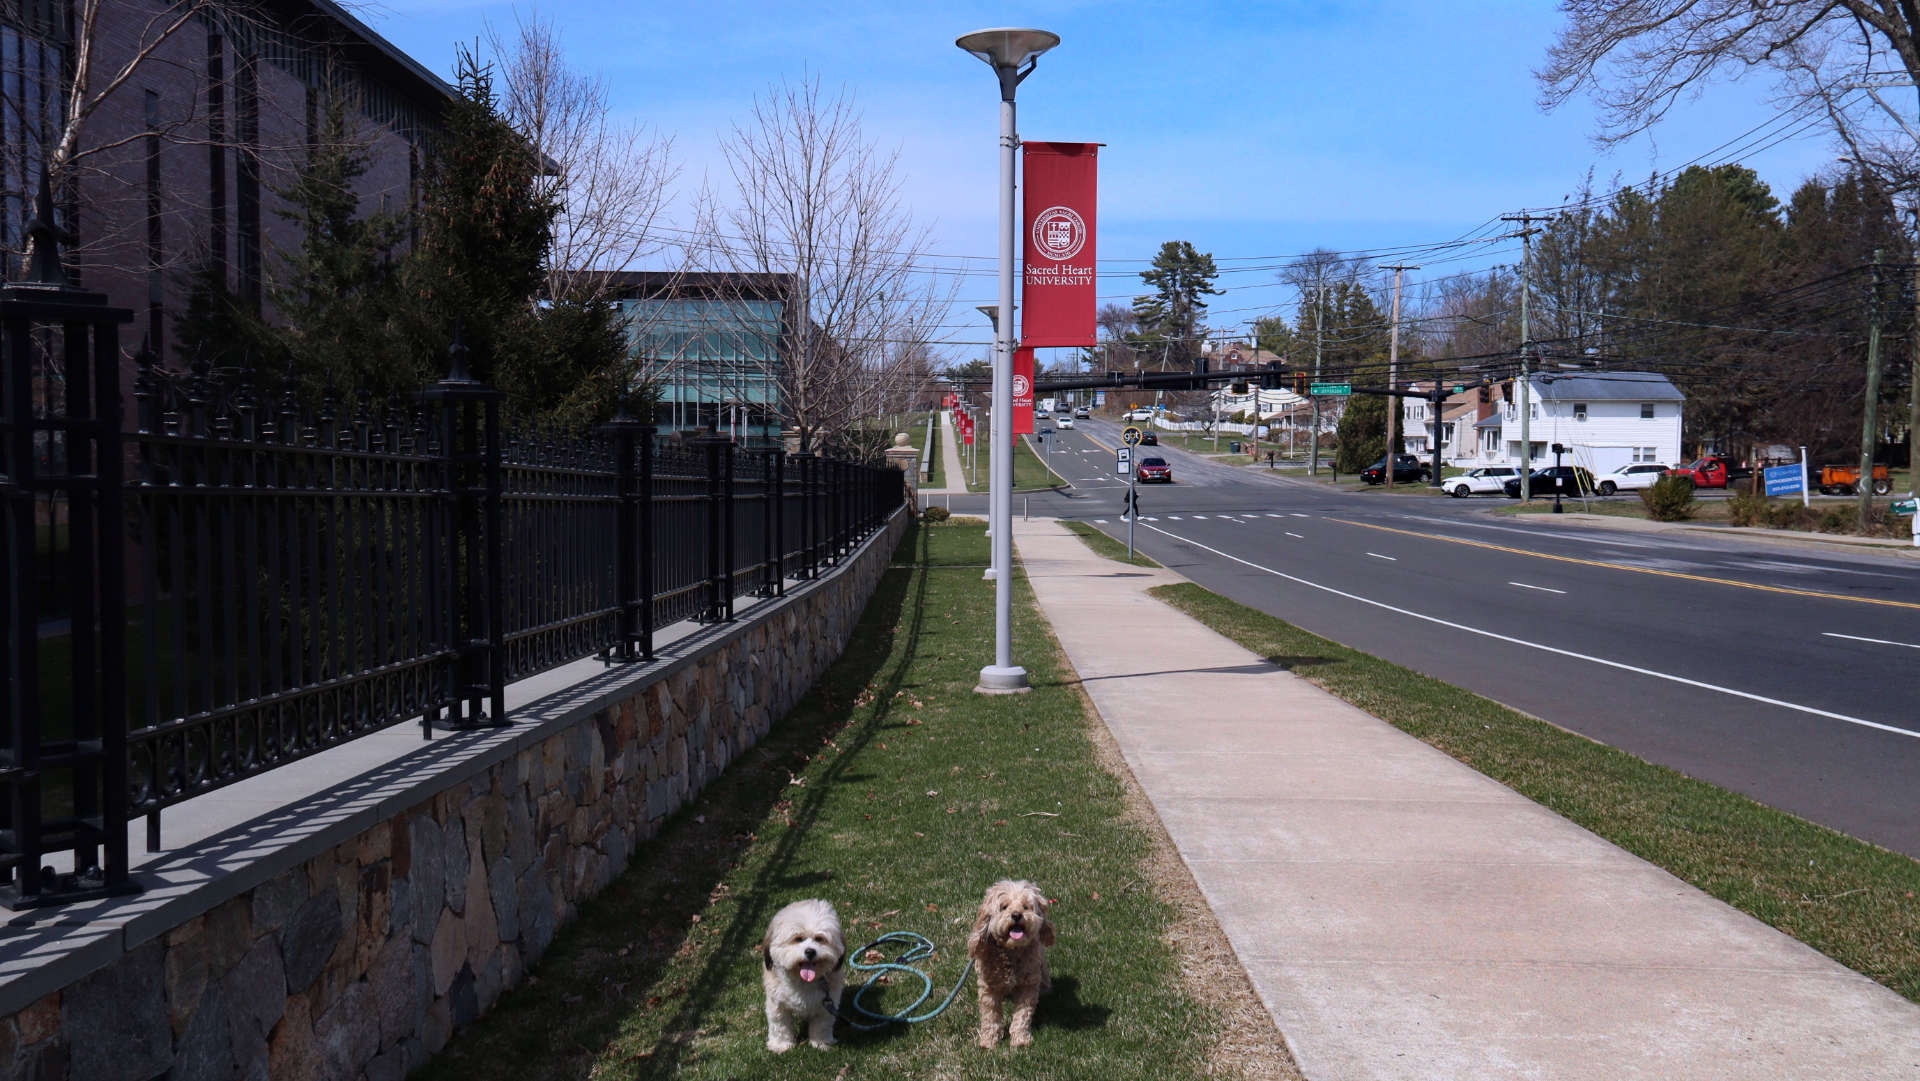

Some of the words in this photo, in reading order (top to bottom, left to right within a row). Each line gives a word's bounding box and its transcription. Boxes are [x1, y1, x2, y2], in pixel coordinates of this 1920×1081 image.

[1026, 264, 1059, 275] Sacred
[1062, 264, 1092, 275] Heart
[1026, 276, 1092, 285] UNIVERSITY
